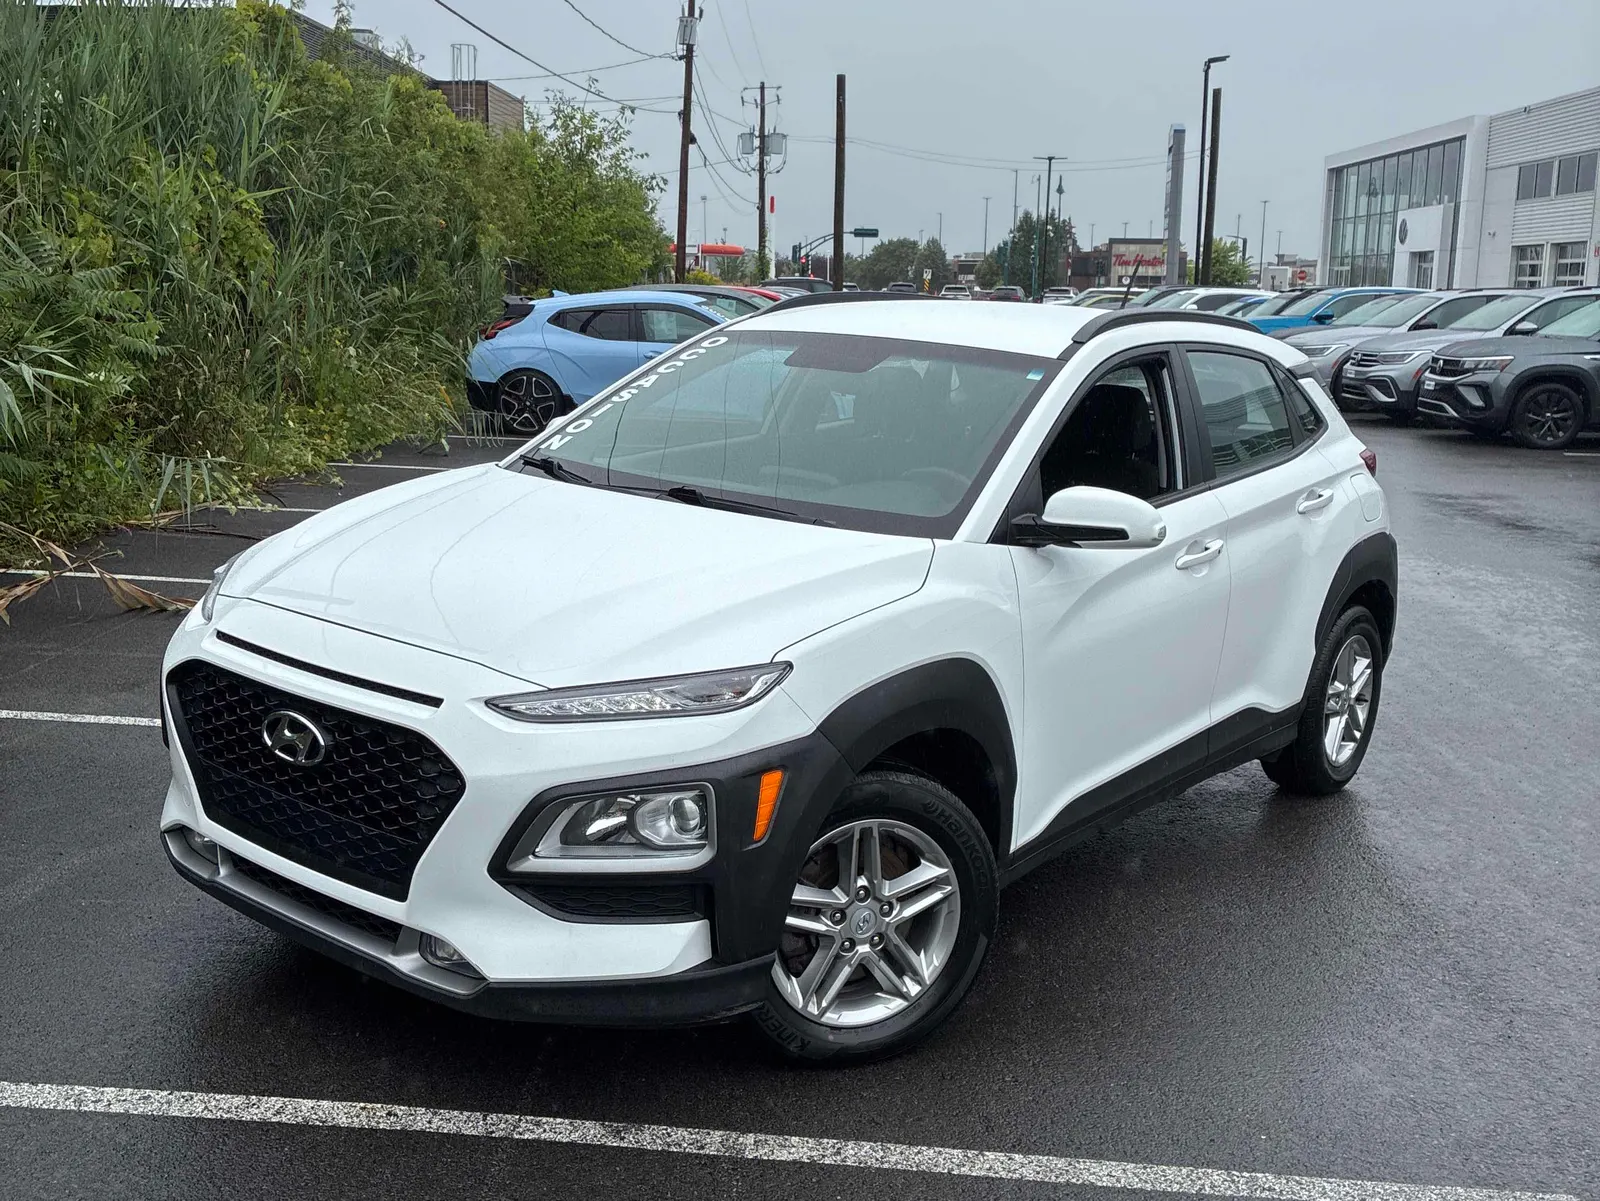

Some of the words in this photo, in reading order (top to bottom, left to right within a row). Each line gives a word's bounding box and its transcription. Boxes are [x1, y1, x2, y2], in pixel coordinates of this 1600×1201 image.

[1113, 253, 1132, 266] Tim
[1132, 253, 1165, 267] Horton
[539, 336, 729, 451] OCCASION
[755, 1003, 812, 1052] KINER
